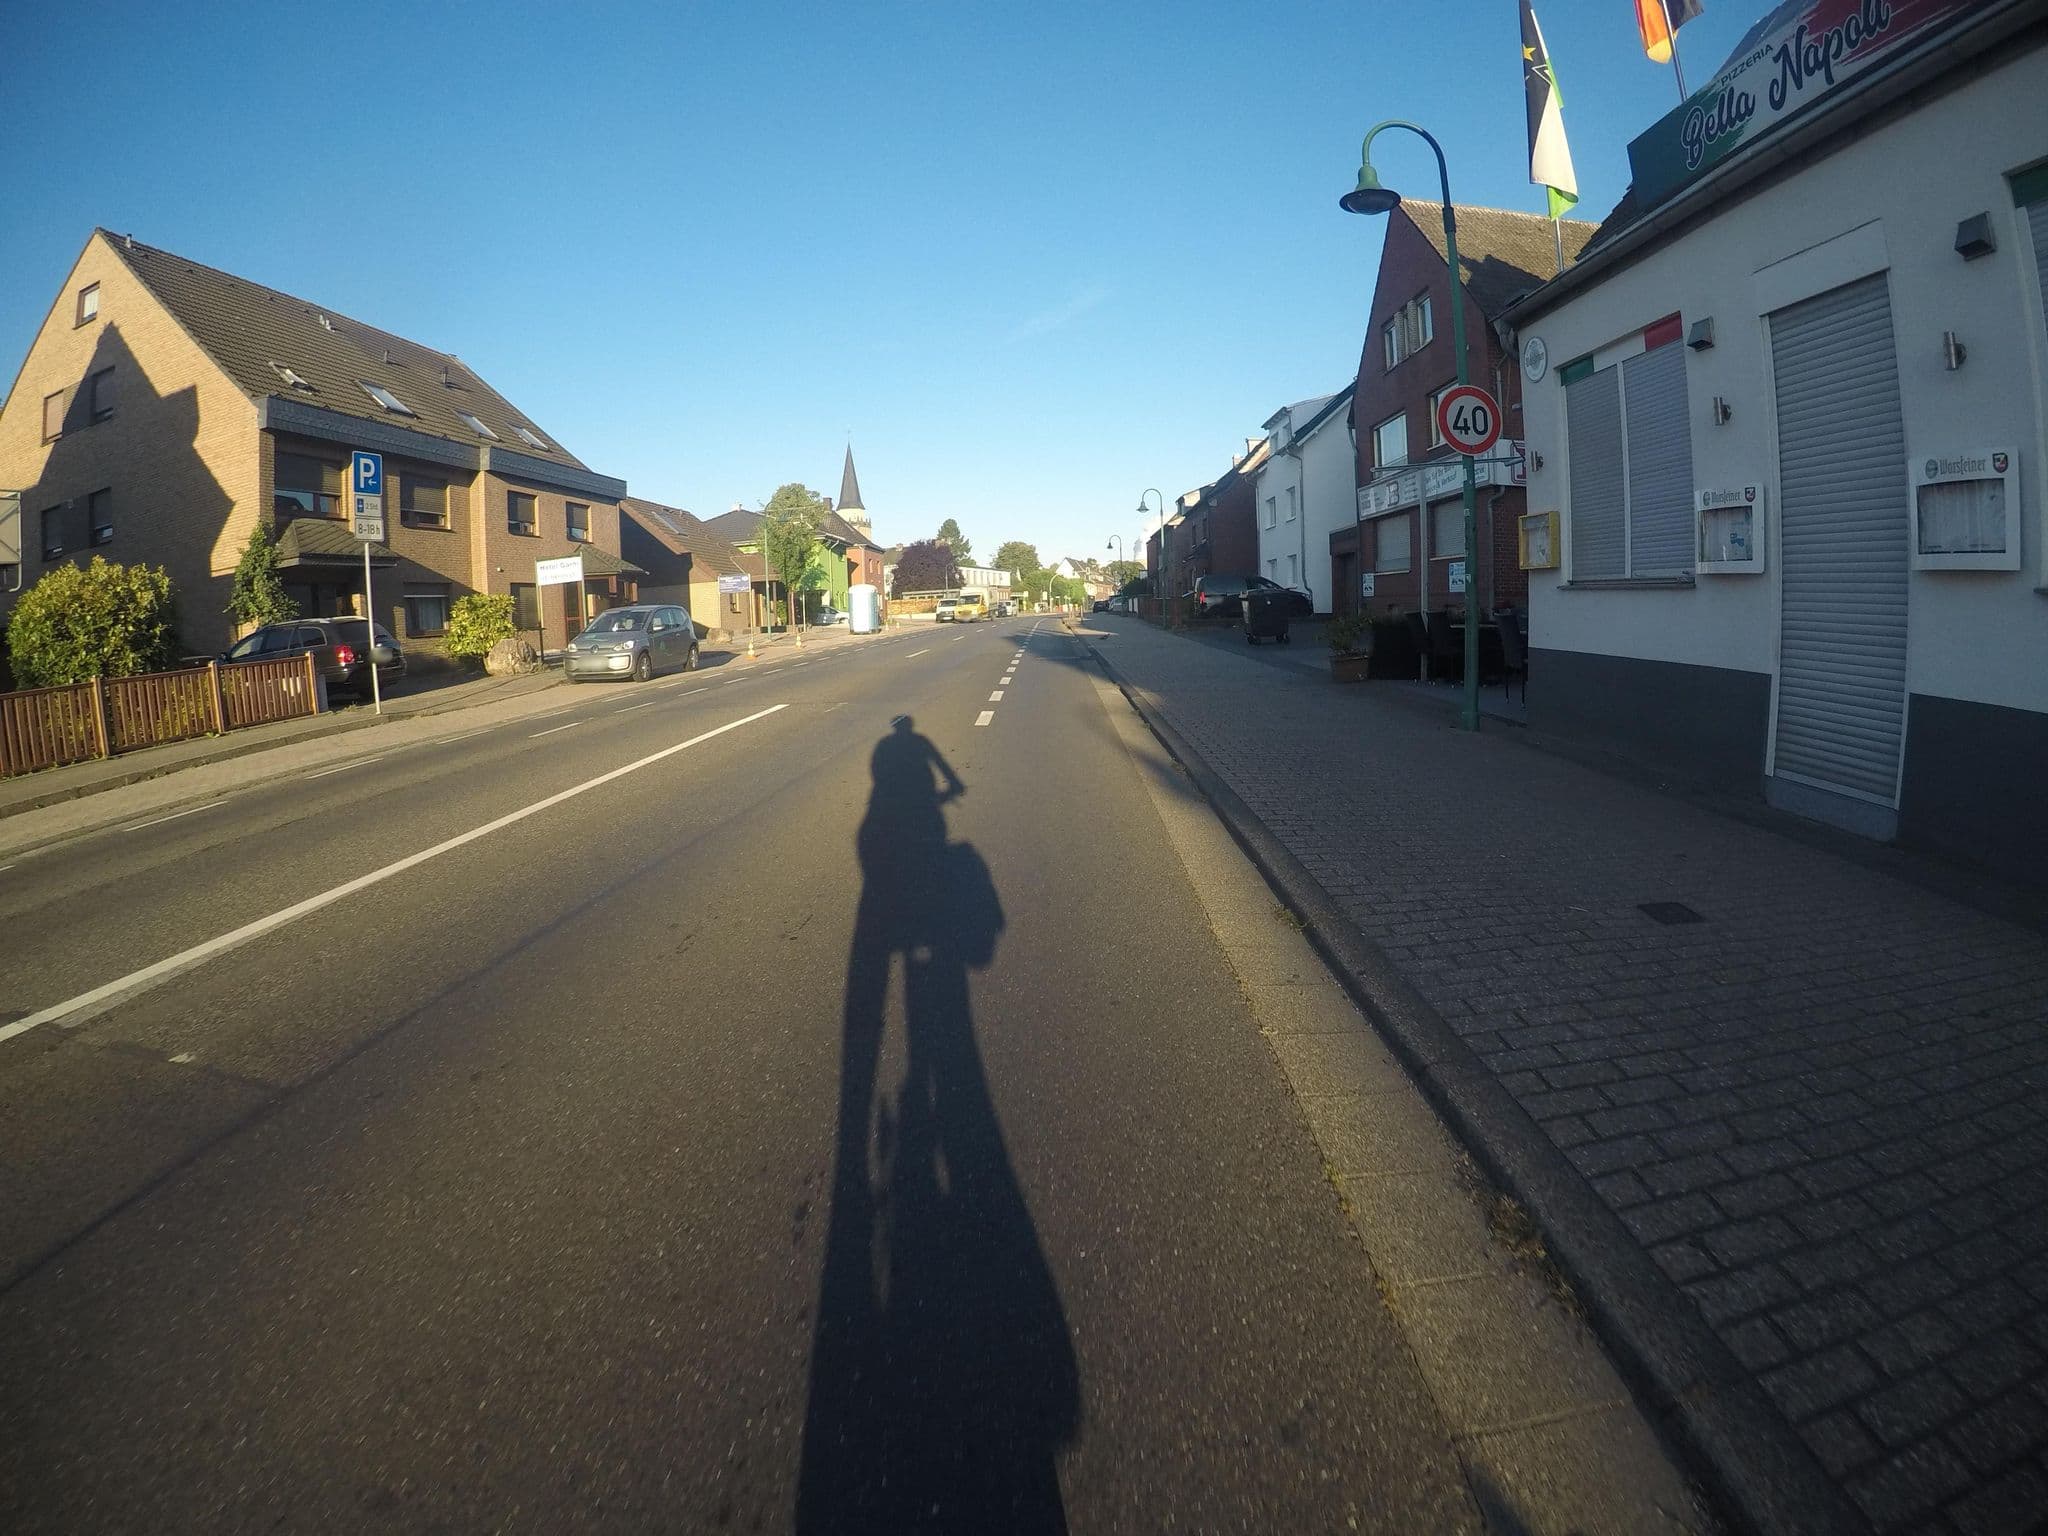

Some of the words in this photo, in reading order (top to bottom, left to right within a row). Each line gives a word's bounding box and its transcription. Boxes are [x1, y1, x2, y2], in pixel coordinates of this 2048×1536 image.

[1721, 44, 1774, 87] PIZZERIA
[1681, 86, 1756, 170] Bella
[1768, 0, 1891, 111] Napoli
[1453, 405, 1488, 436] 40
[359, 458, 375, 488] P
[358, 523, 375, 534] 8-18
